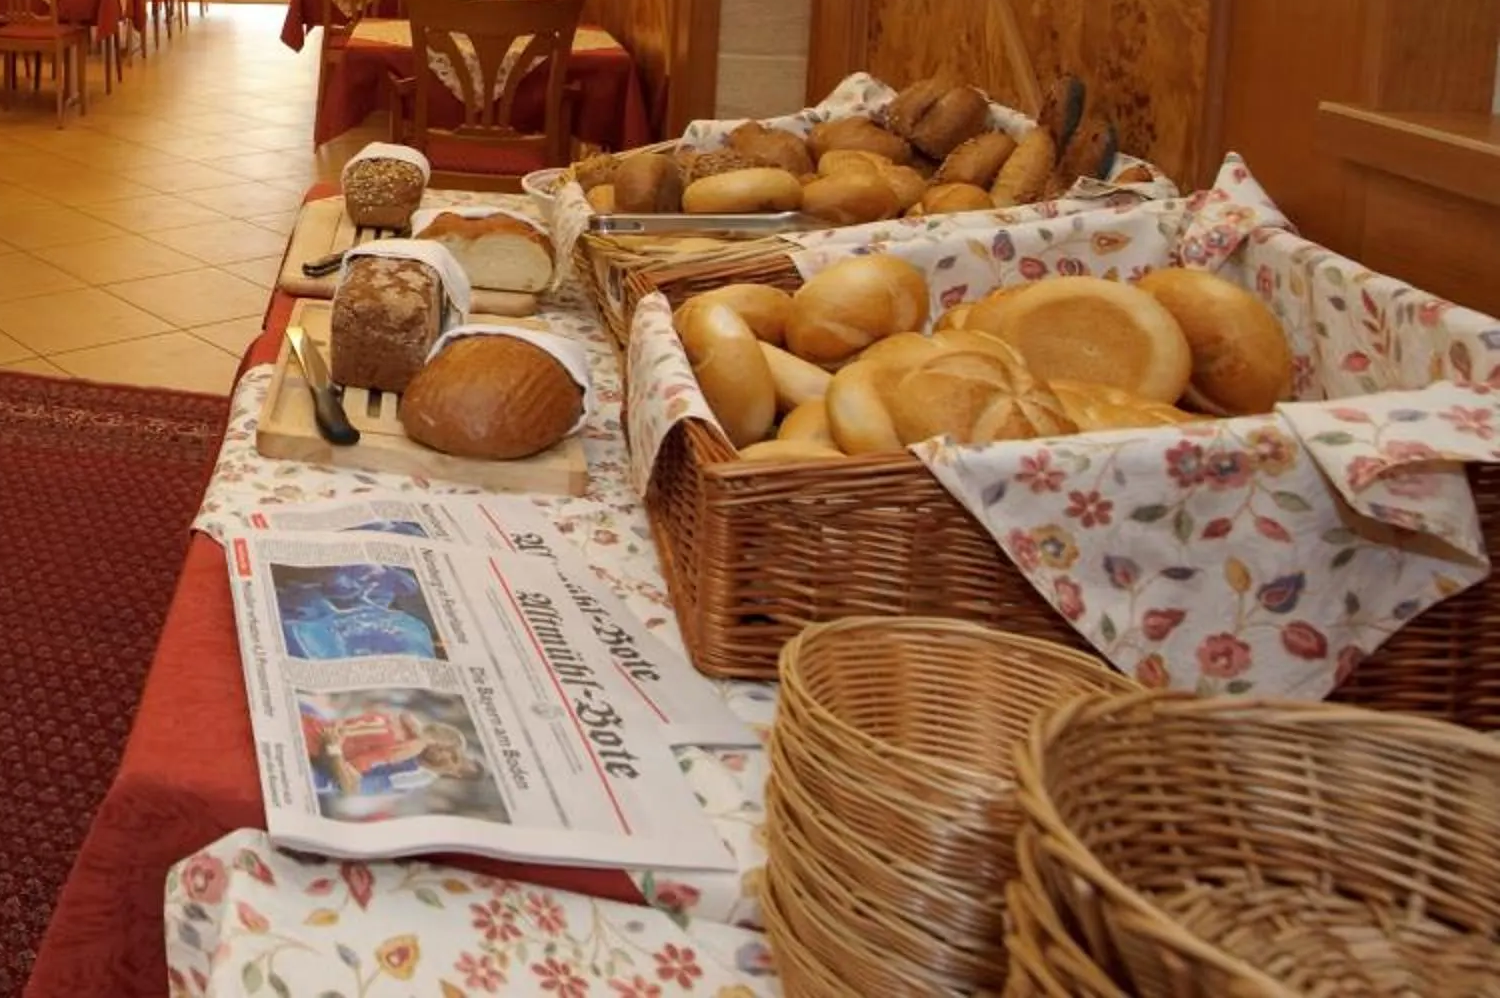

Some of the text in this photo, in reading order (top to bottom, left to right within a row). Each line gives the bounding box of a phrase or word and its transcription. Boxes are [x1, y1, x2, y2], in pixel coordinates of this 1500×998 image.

[468, 666, 529, 791] Die Bayern am Boden
[516, 589, 641, 779] Altmühl-Bote
